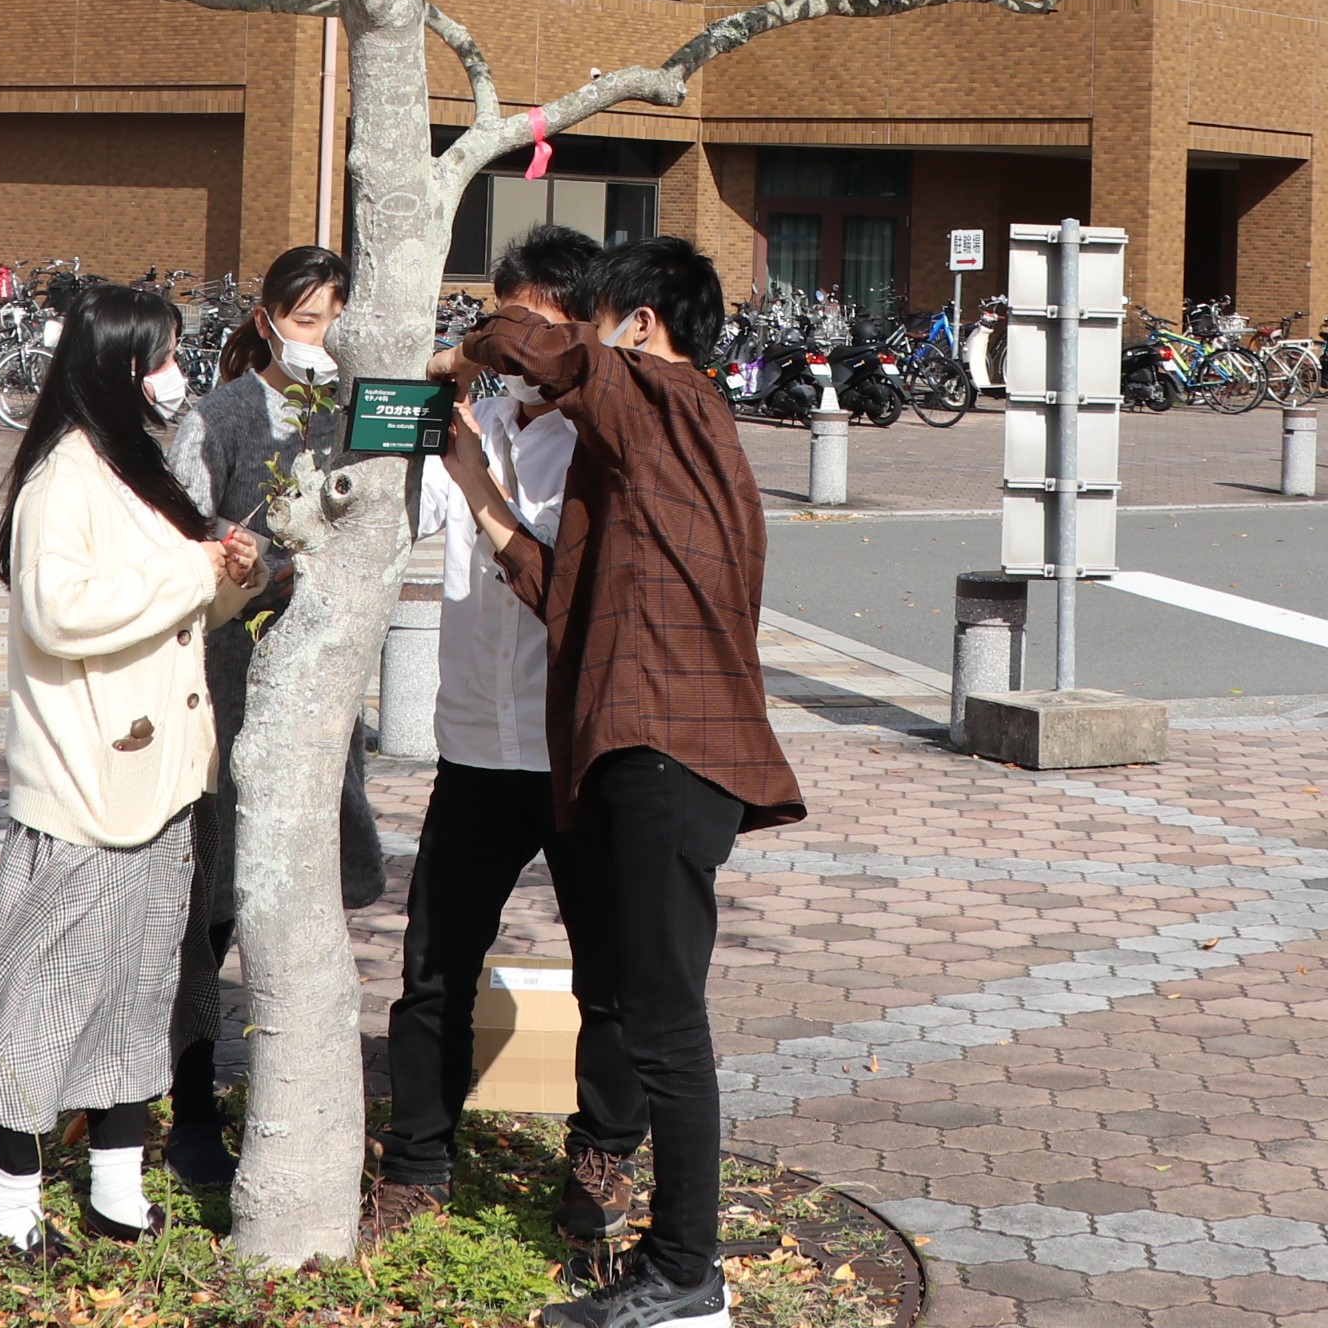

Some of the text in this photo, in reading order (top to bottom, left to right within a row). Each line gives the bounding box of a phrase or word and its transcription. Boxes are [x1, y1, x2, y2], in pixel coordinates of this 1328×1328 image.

[376, 405, 430, 416] クロガネモチ
